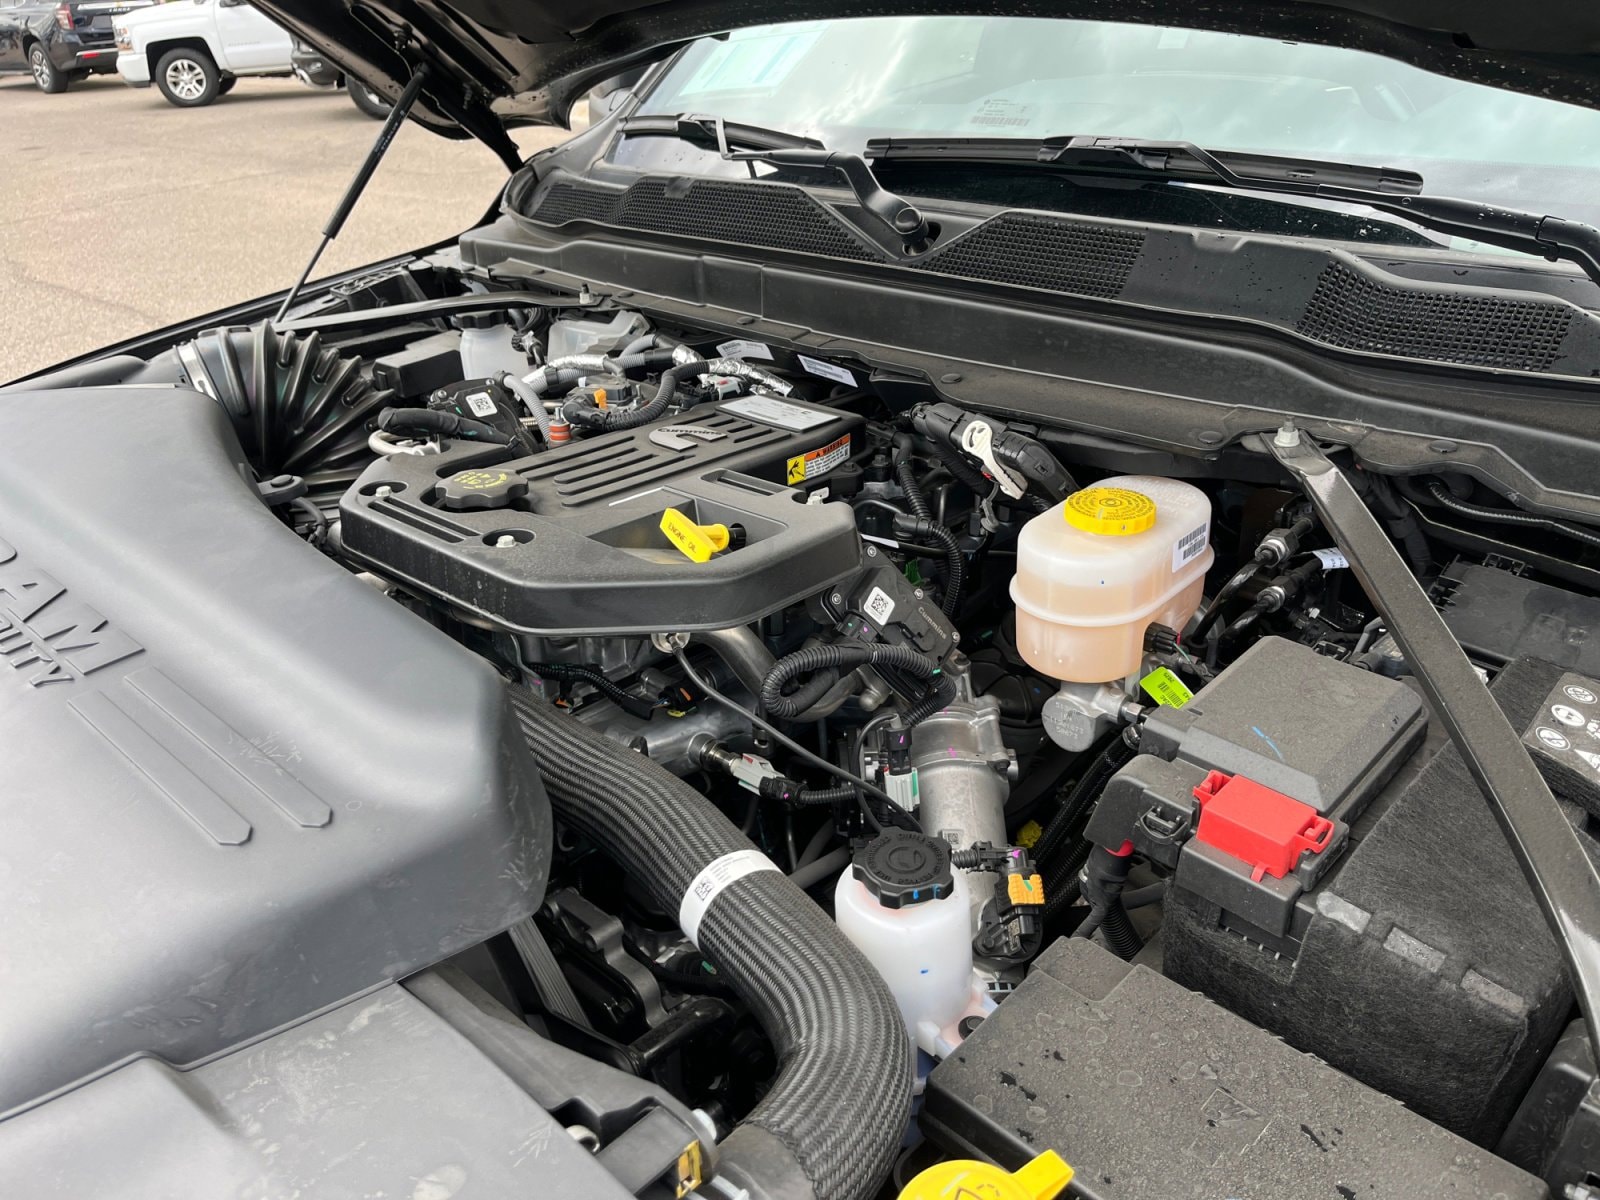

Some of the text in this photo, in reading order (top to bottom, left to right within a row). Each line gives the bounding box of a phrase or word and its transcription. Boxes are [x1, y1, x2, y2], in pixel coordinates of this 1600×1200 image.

[668, 521, 697, 554] ENGINE OIL
[918, 606, 947, 639] Cummins
